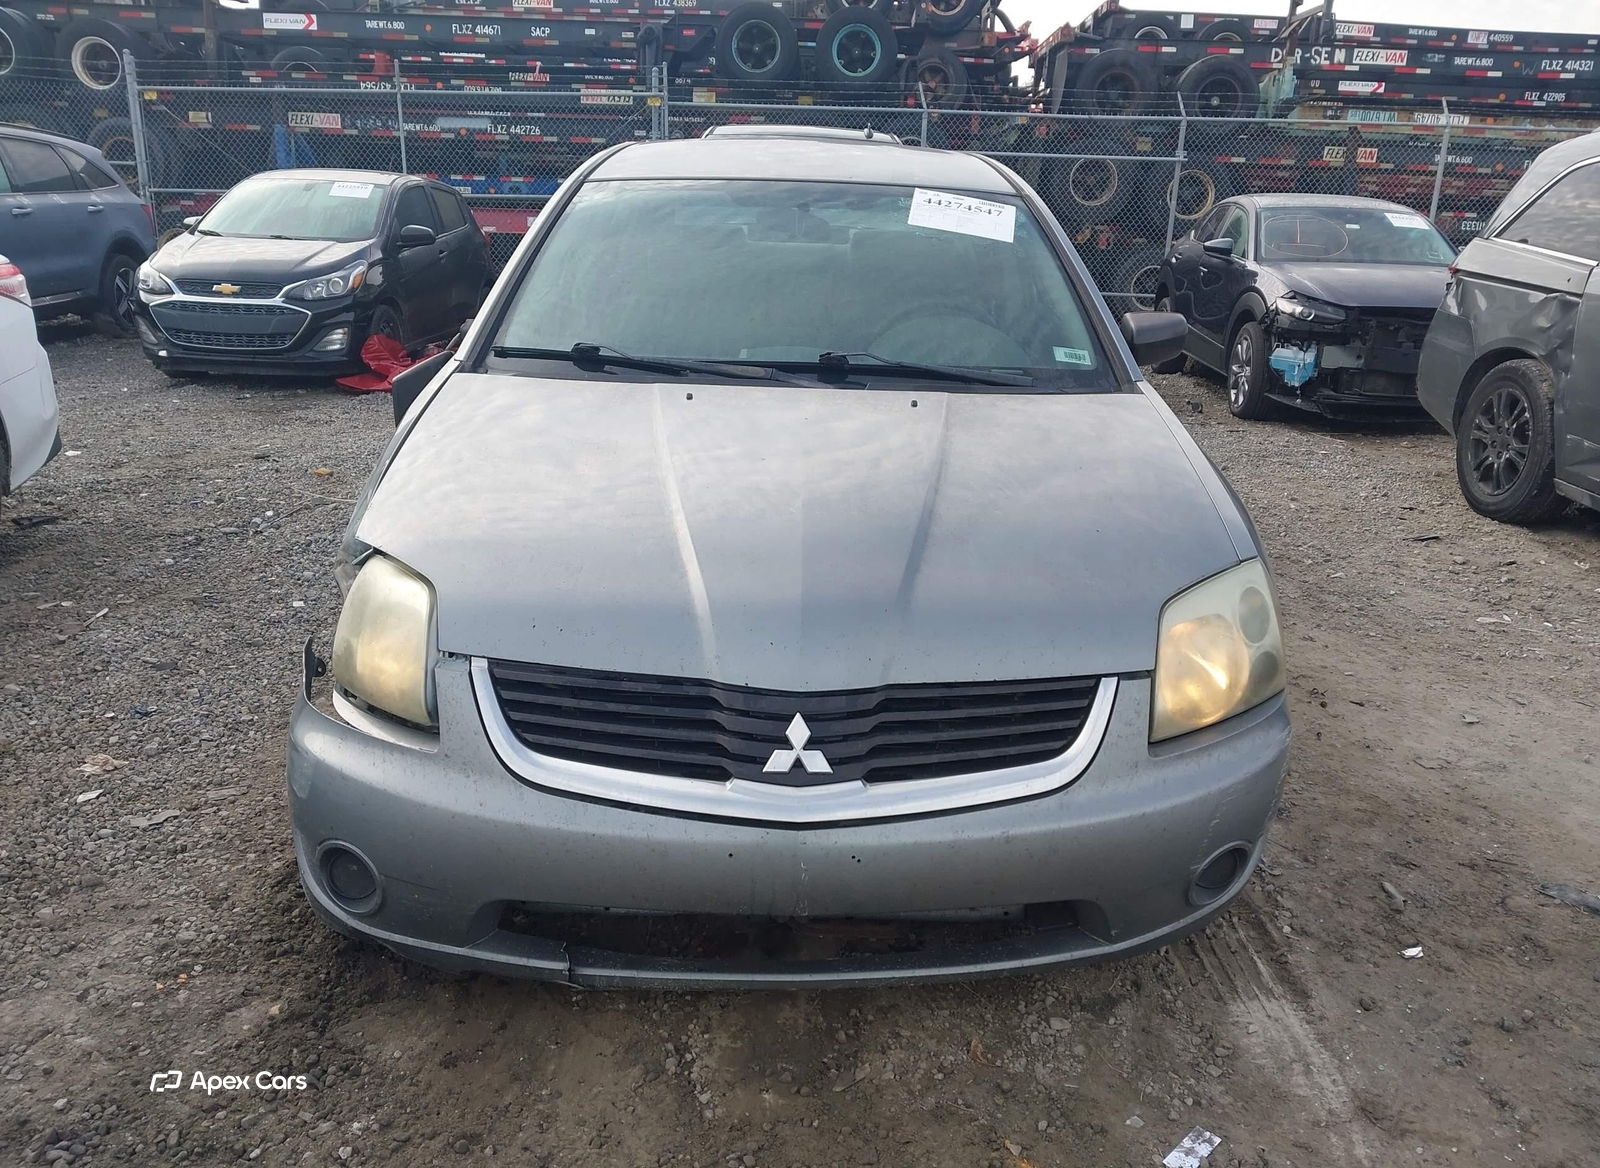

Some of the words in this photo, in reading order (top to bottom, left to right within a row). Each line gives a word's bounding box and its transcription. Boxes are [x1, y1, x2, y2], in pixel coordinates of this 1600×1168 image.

[452, 24, 472, 34] FLXZ
[475, 24, 501, 35] 414671
[530, 26, 551, 37] SACP
[1354, 49, 1407, 65] FLEXI-VAN
[1541, 60, 1562, 71] FLXZ
[1565, 60, 1595, 71] 414321
[1525, 91, 1540, 101] FLXZ
[1542, 92, 1566, 102] 422905
[487, 124, 507, 134] FLXZ
[509, 125, 541, 135] 442726
[923, 197, 1003, 217] 44274547
